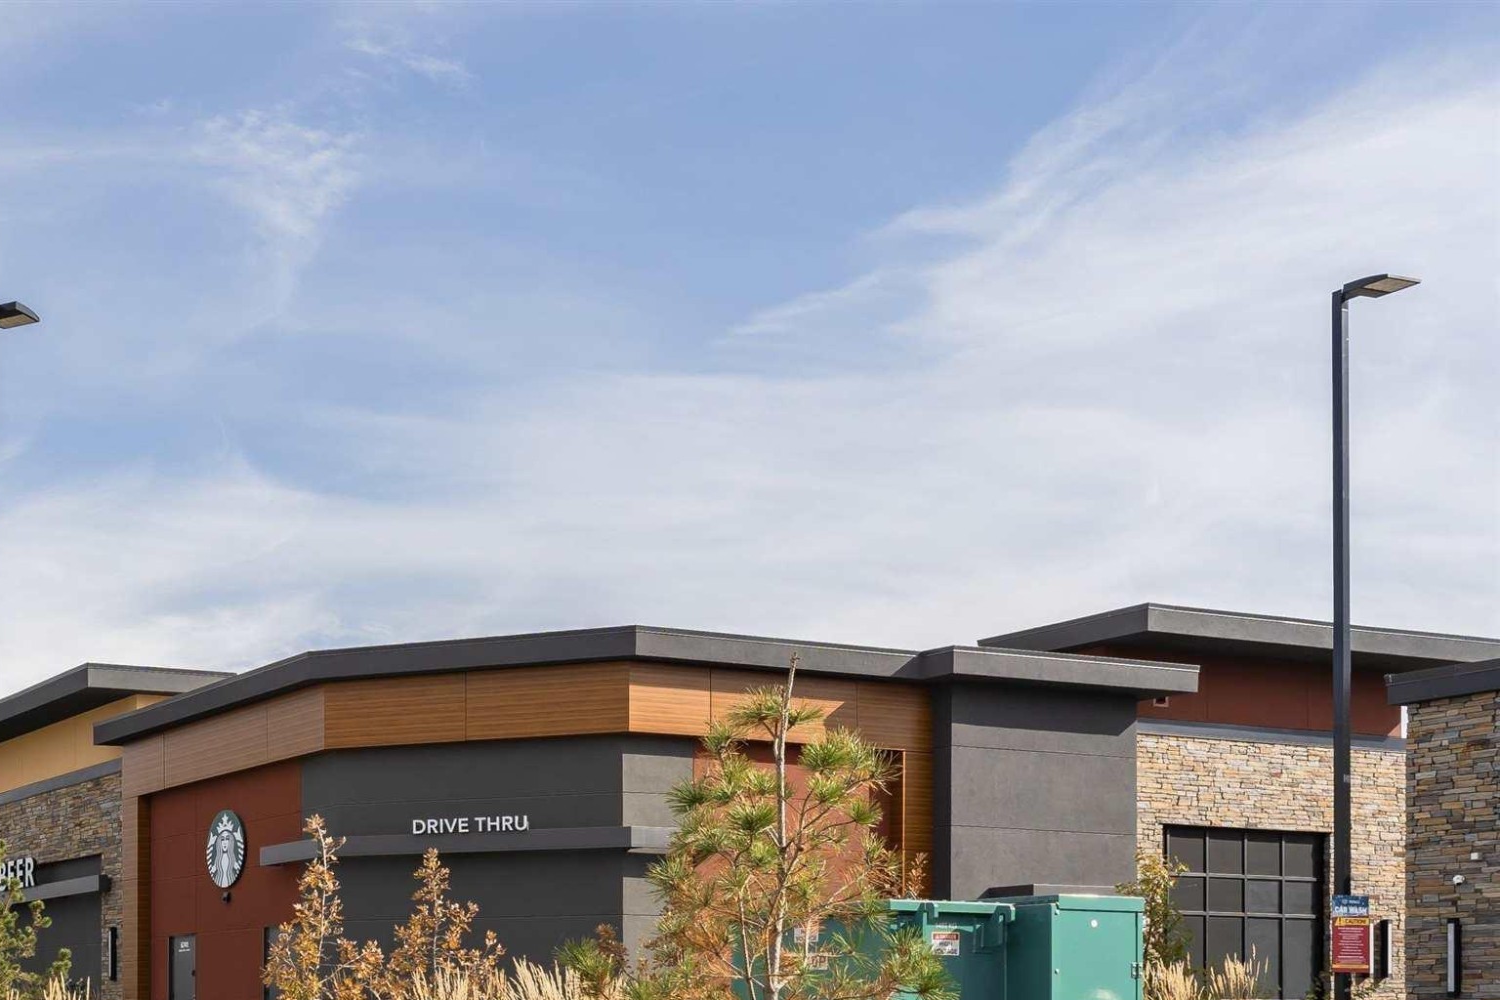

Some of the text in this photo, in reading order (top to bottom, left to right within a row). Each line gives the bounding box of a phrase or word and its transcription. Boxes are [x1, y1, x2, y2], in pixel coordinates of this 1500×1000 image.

[412, 815, 528, 834] DRIVE THRU
[0, 857, 36, 891] BEER
[1334, 905, 1367, 913] CAR WASH
